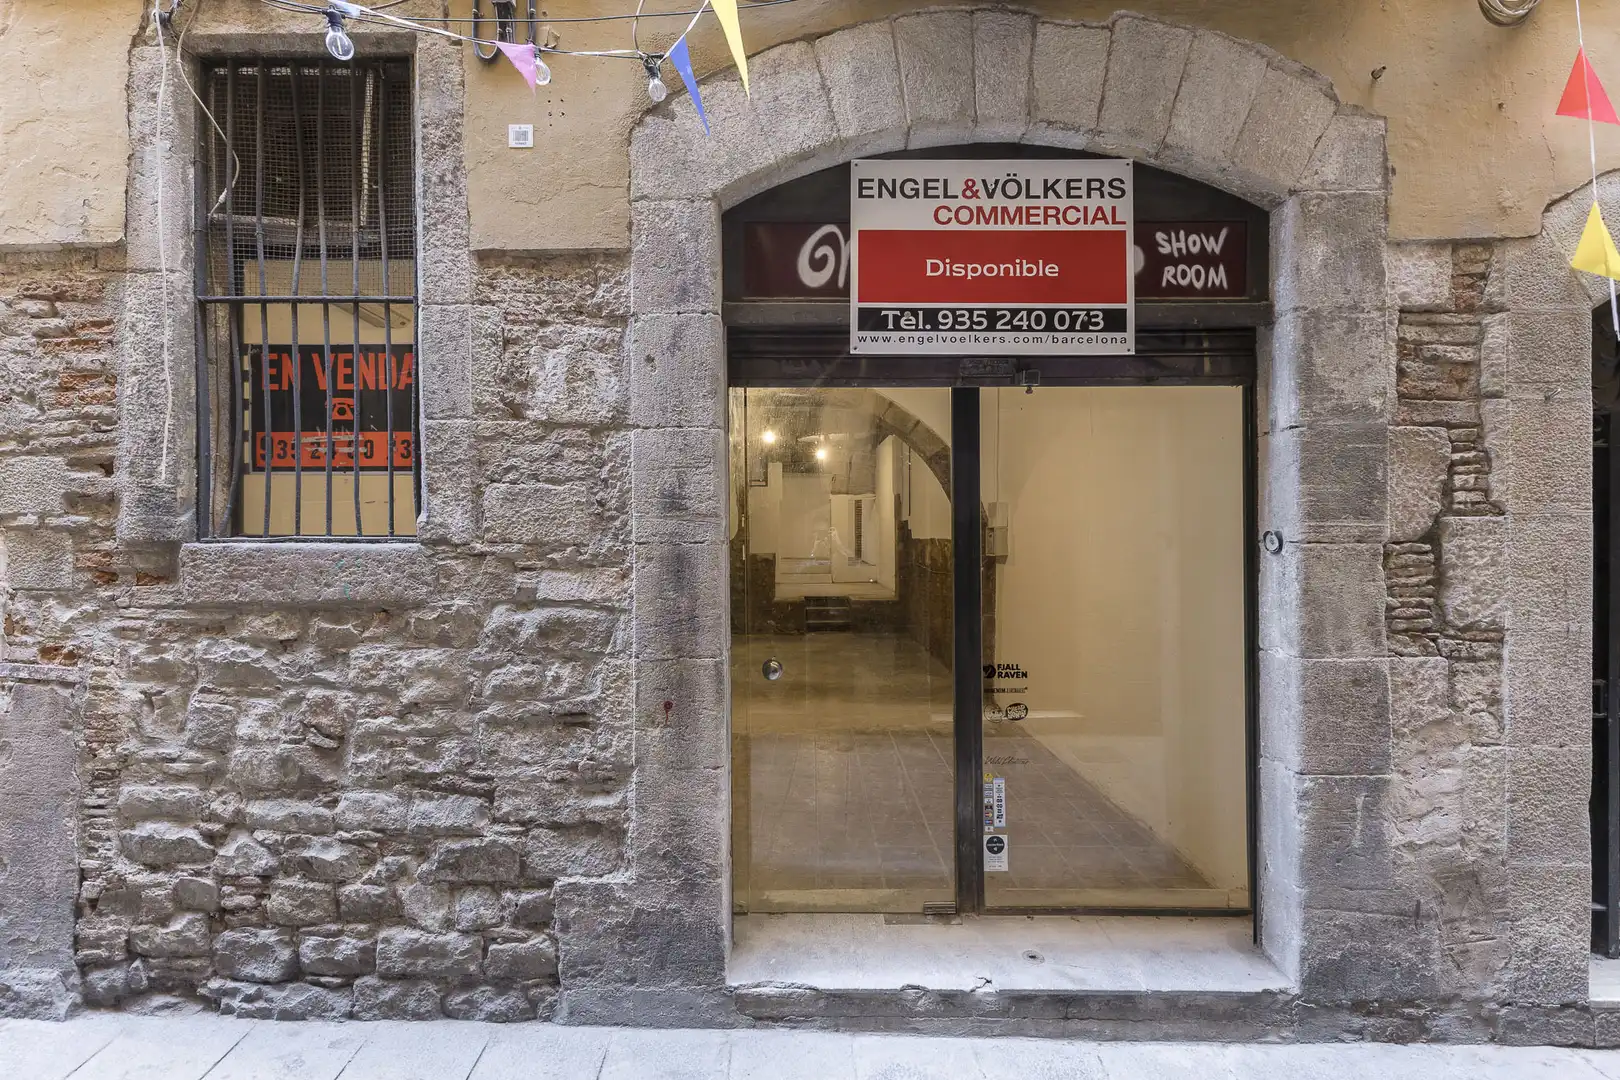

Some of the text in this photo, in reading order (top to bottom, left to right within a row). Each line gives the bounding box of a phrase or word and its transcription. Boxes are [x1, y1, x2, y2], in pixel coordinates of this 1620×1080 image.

[857, 172, 1127, 200] ENGEL&VÖLKERS
[933, 205, 1127, 226] COMMERCIAL
[1155, 226, 1228, 258] SHOW
[925, 258, 1060, 280] Disponible
[1161, 262, 1228, 290] ROOM
[937, 310, 988, 330] 935
[995, 310, 1047, 330] 240
[1053, 310, 1105, 330] 073
[857, 333, 1128, 346] www.engelvoelkers.com/barcelona
[261, 352, 414, 391] EN VENDA
